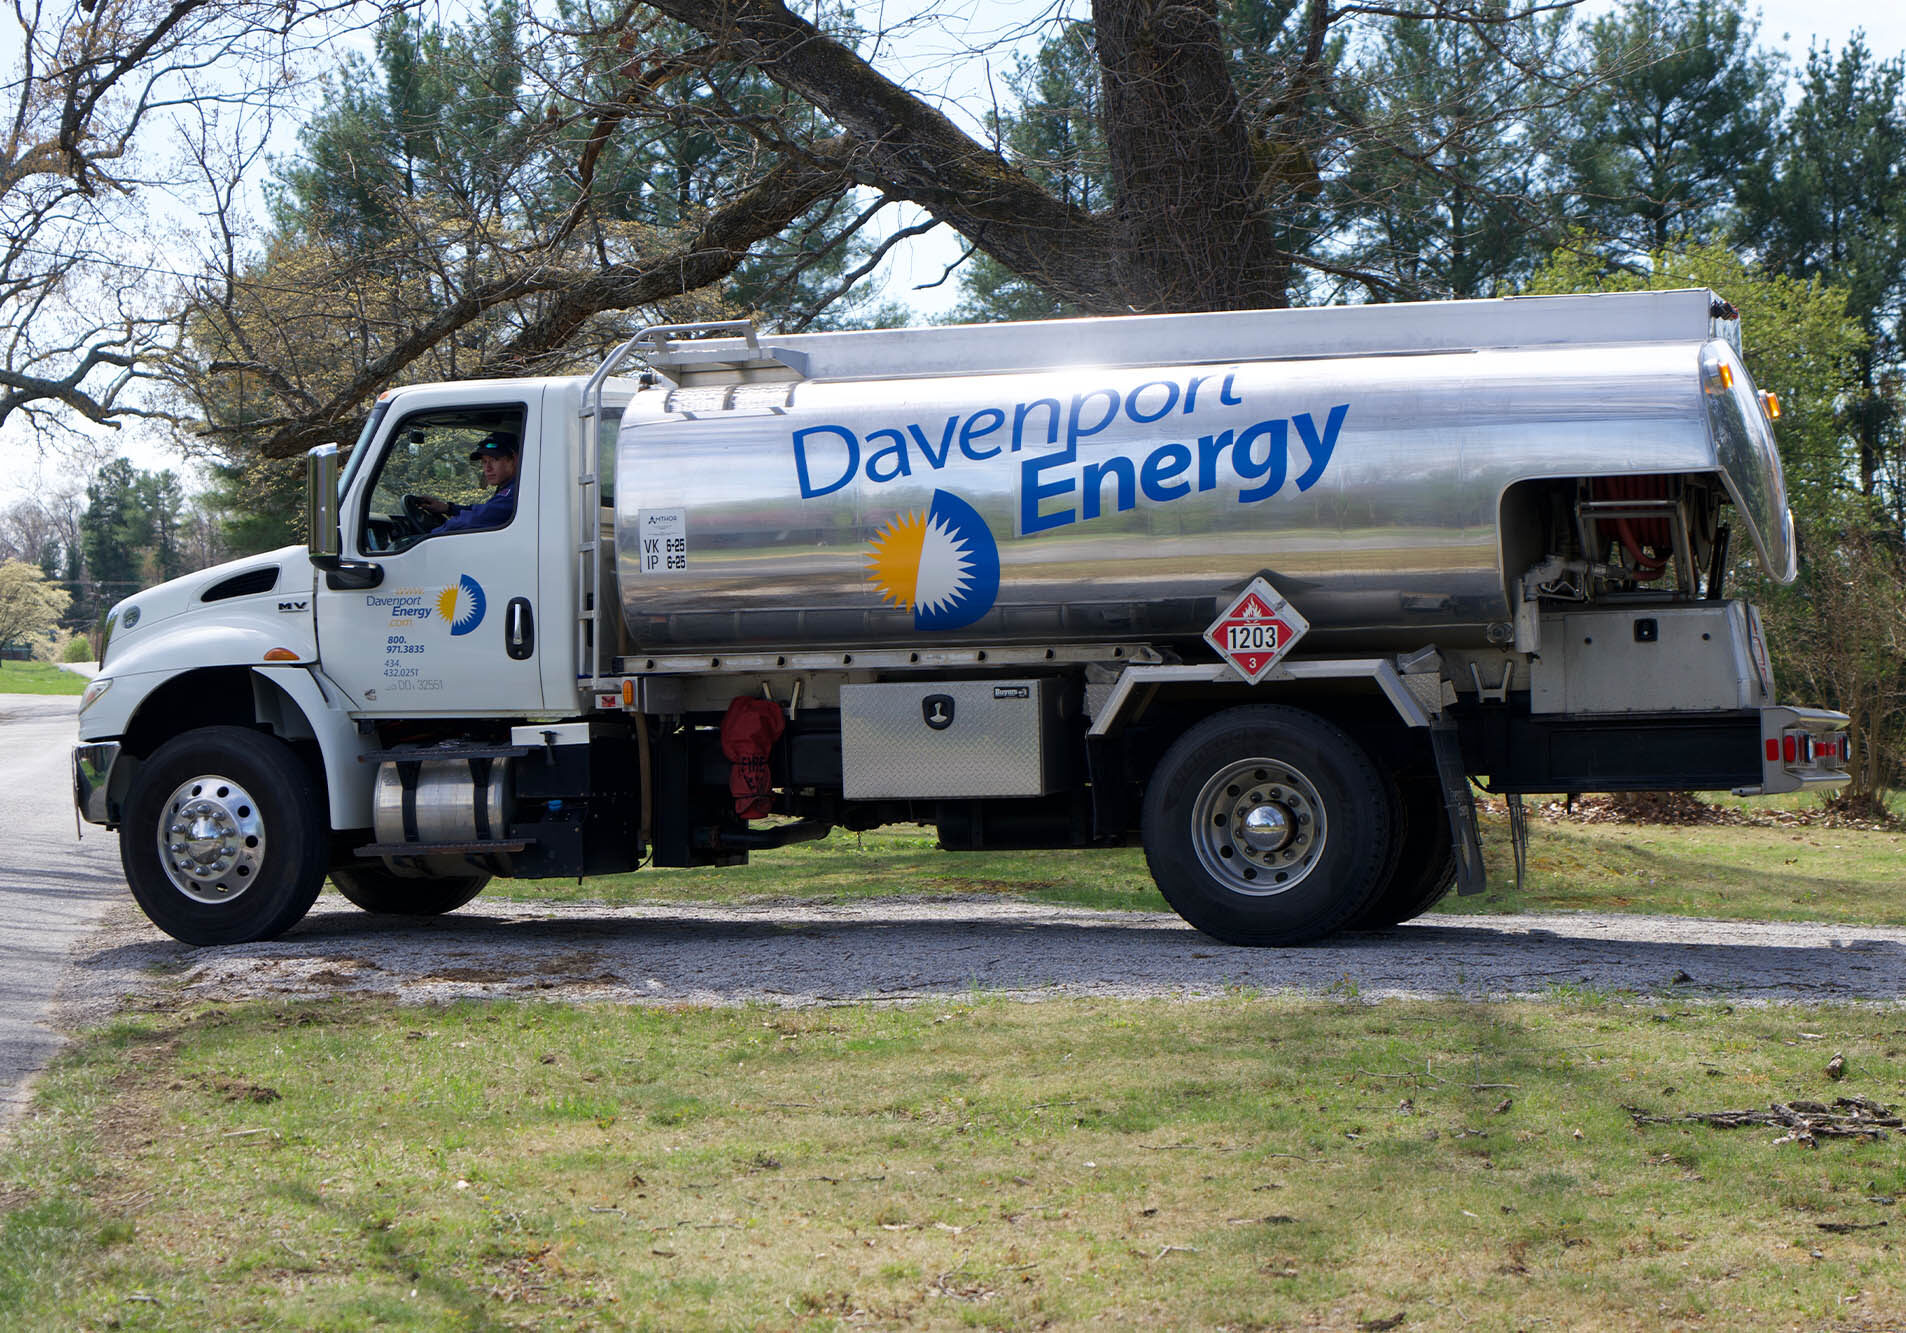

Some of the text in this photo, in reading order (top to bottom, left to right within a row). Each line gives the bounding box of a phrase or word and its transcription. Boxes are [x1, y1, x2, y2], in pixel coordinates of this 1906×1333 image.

[792, 366, 1242, 499] Davenport
[1021, 403, 1350, 536] Energy
[644, 538, 685, 553] VK 6-25
[647, 555, 686, 570] IP 6-25
[278, 601, 308, 611] MV
[366, 595, 422, 608] Davenport
[391, 605, 433, 619] Energy
[387, 635, 407, 644] 800.
[1229, 626, 1276, 649] 1203
[386, 644, 425, 654] 971.3835
[1248, 657, 1257, 669] 3
[384, 668, 418, 677] 432.0251
